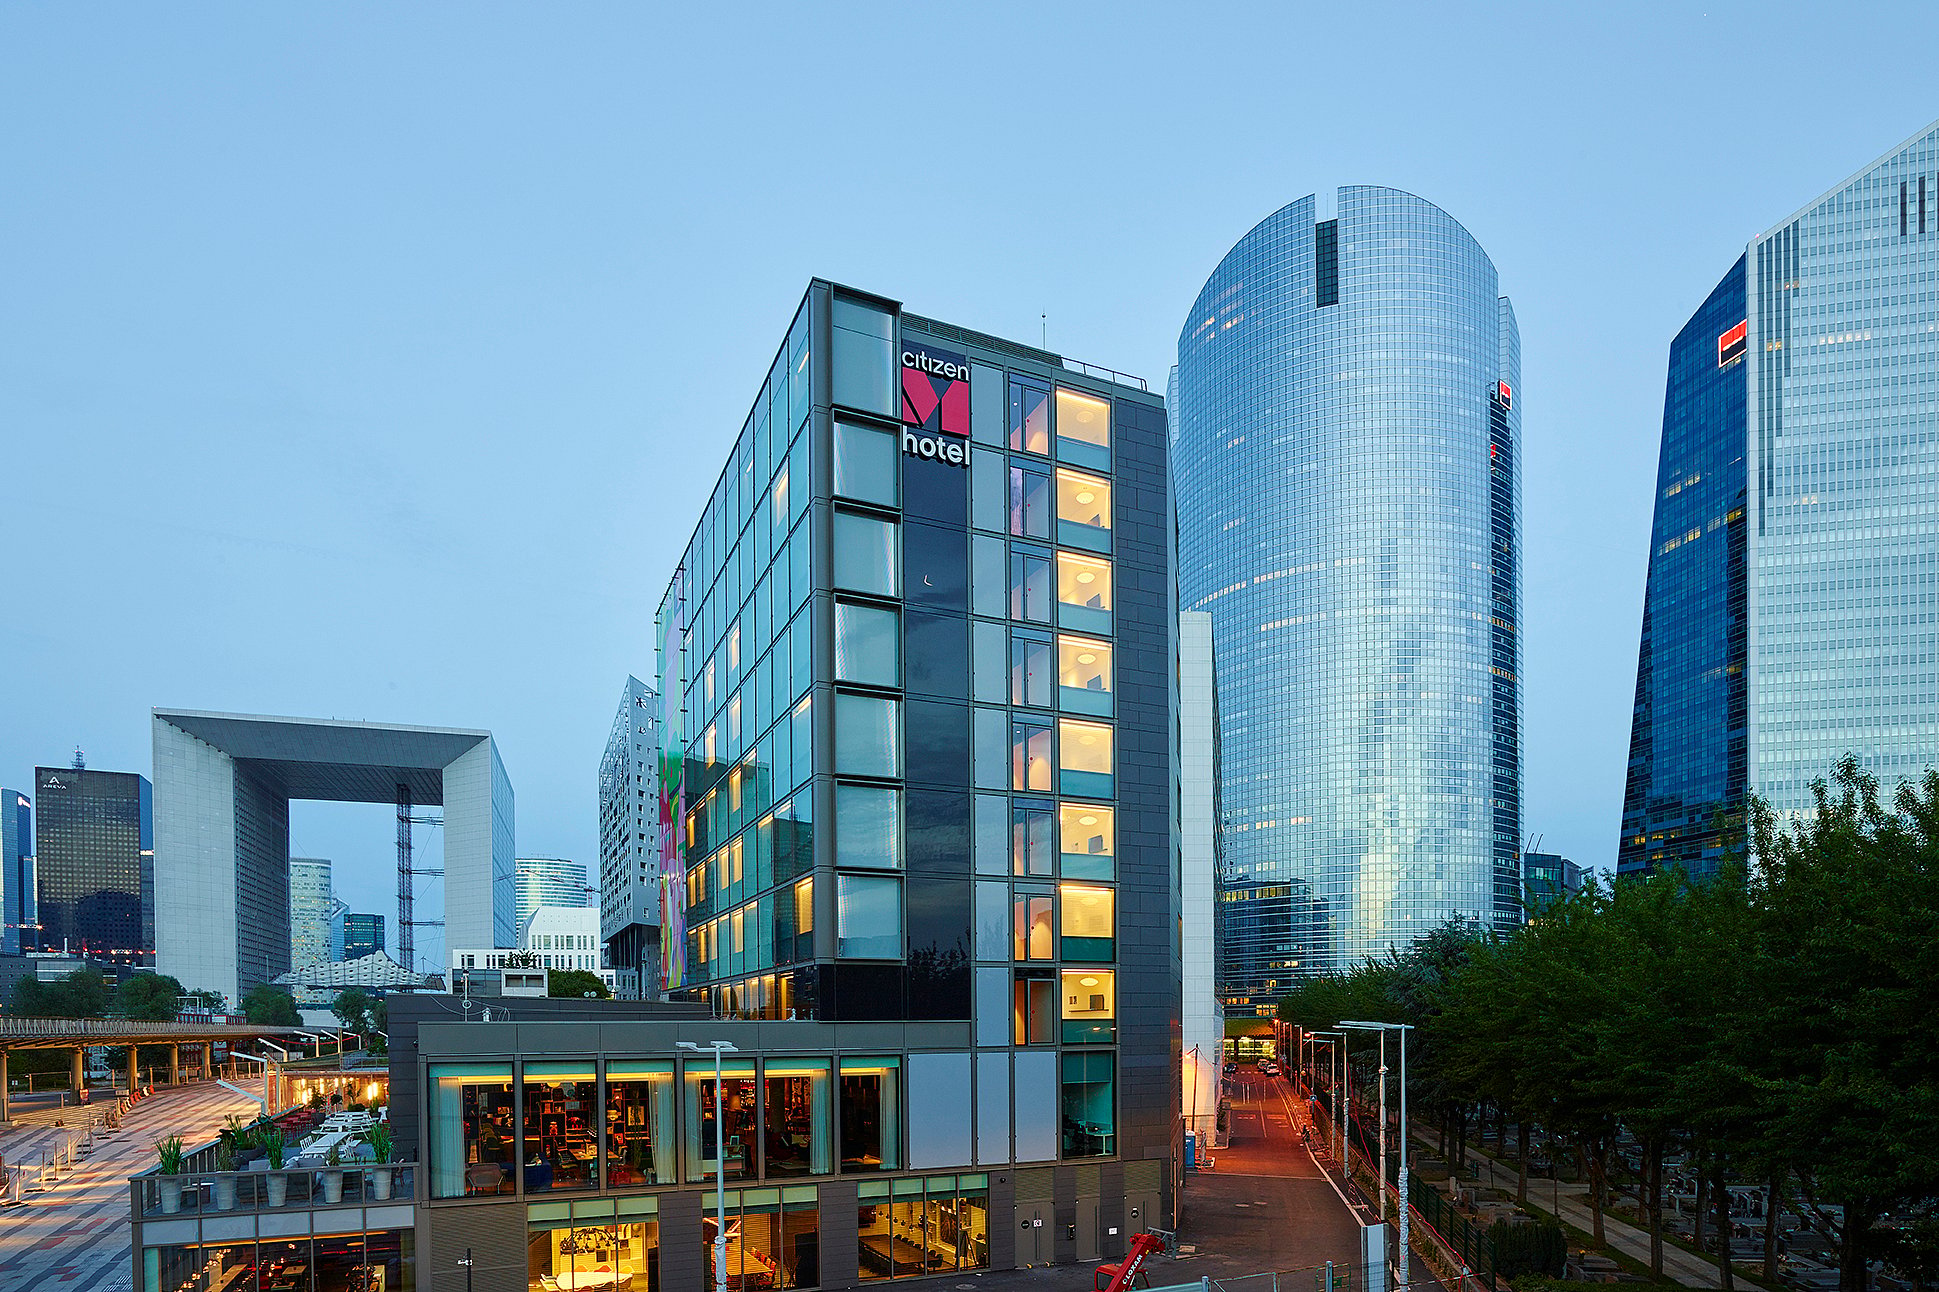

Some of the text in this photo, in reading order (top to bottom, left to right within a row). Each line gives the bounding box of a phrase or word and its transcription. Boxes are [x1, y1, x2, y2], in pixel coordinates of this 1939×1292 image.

[901, 351, 969, 381] citizen
[902, 425, 970, 466] hotel
[1125, 1254, 1143, 1279] LOXAM
